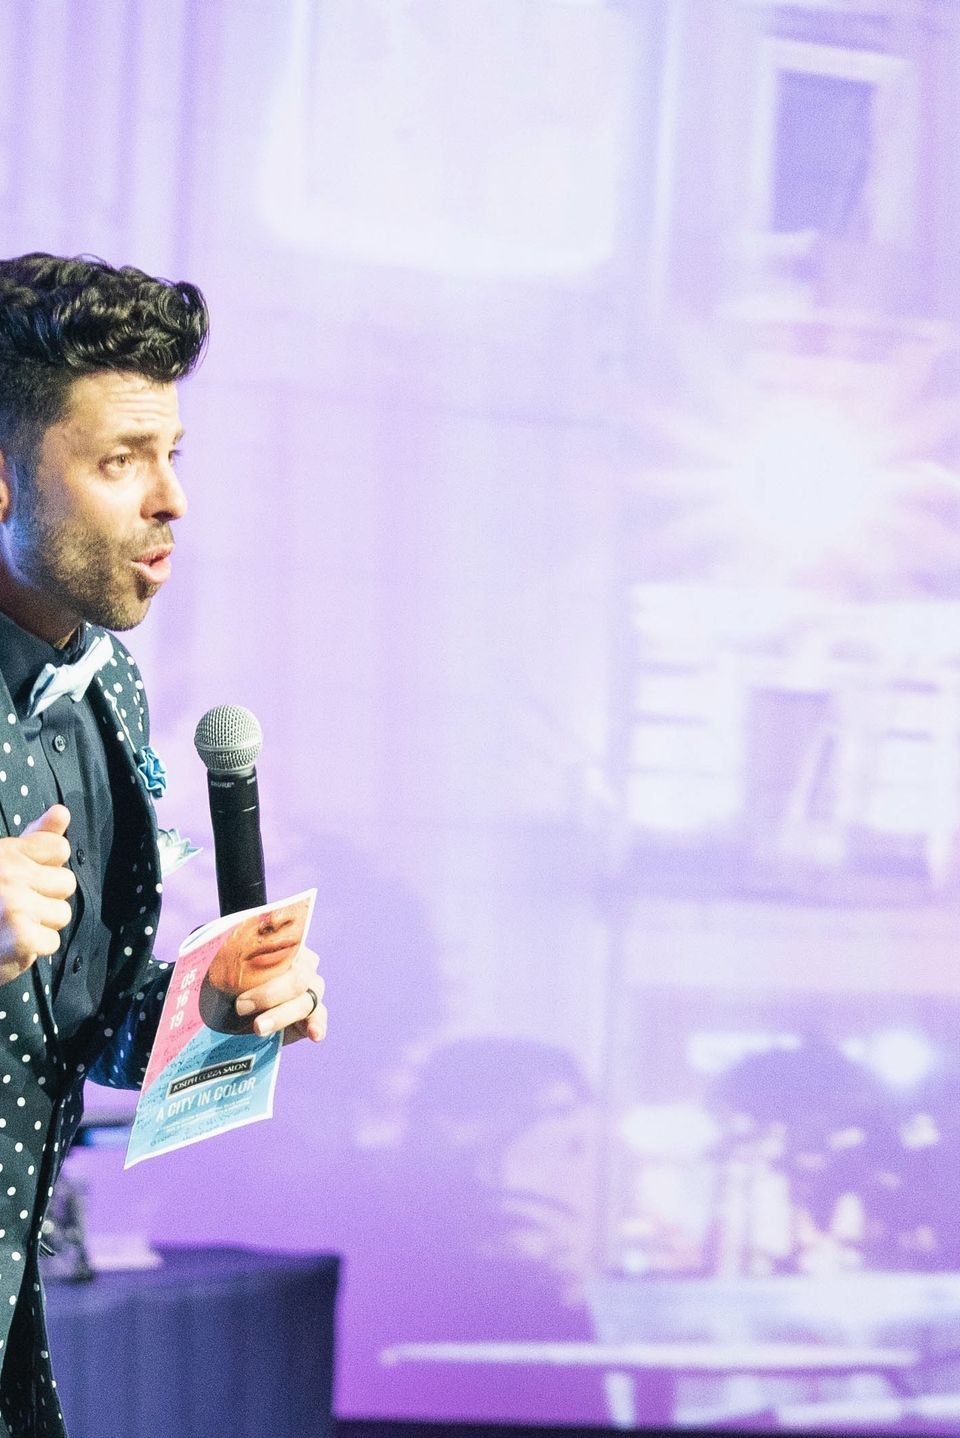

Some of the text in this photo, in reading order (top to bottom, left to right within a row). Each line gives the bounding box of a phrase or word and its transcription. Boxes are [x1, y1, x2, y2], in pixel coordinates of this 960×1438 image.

[180, 967, 198, 990] 05
[176, 989, 191, 1010] 16
[169, 1009, 185, 1031] 19
[173, 1076, 198, 1092] JOSEPH
[223, 1062, 249, 1074] SALON
[156, 1106, 165, 1122] A
[167, 1093, 196, 1117] CITY
[197, 1089, 212, 1108] IN
[213, 1076, 257, 1101] COLOR
